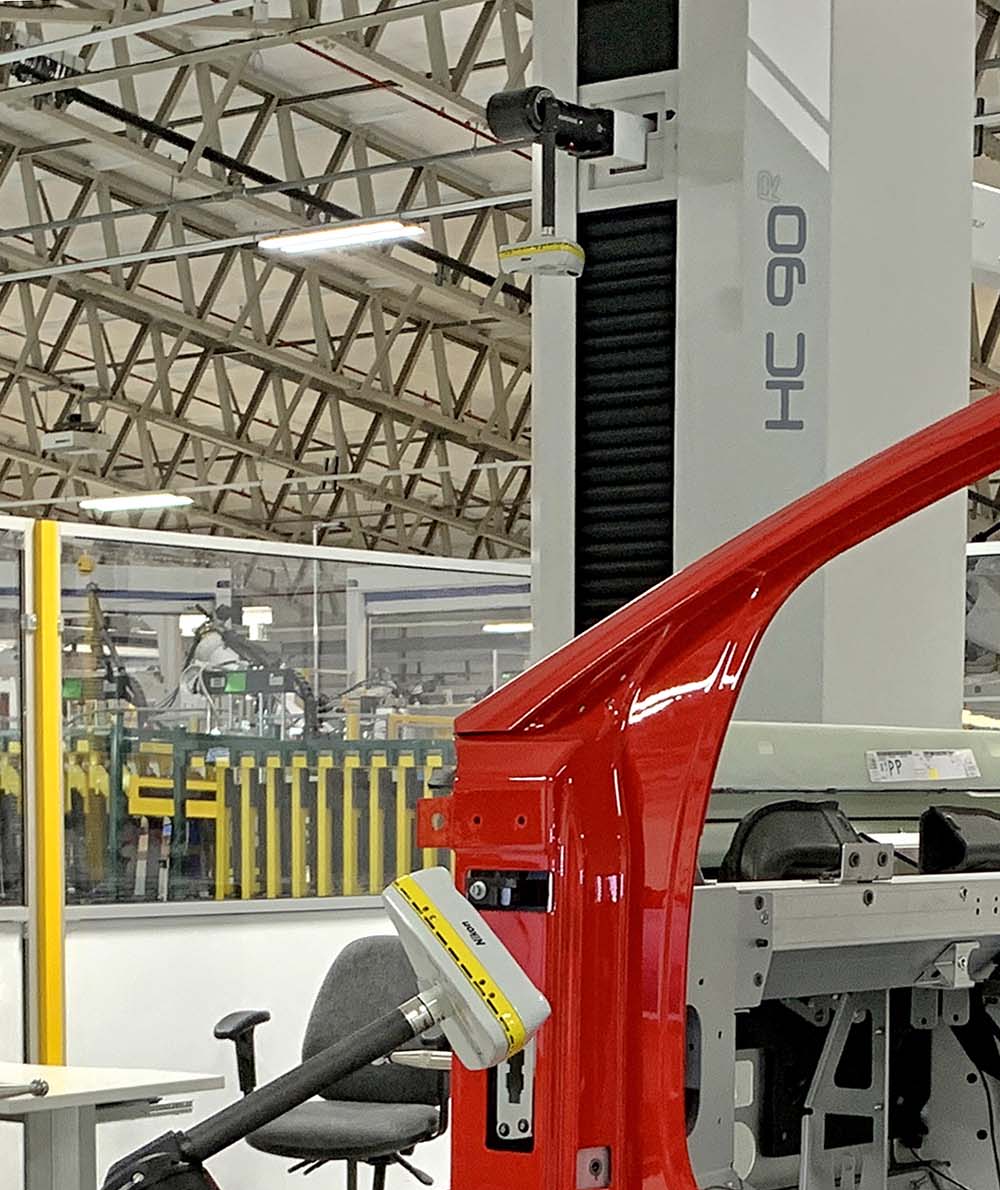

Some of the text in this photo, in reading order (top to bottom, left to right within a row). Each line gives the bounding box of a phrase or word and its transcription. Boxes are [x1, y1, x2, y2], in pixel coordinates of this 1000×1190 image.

[766, 205, 807, 306] 90
[764, 331, 806, 430] HC
[461, 920, 486, 946] Nikon
